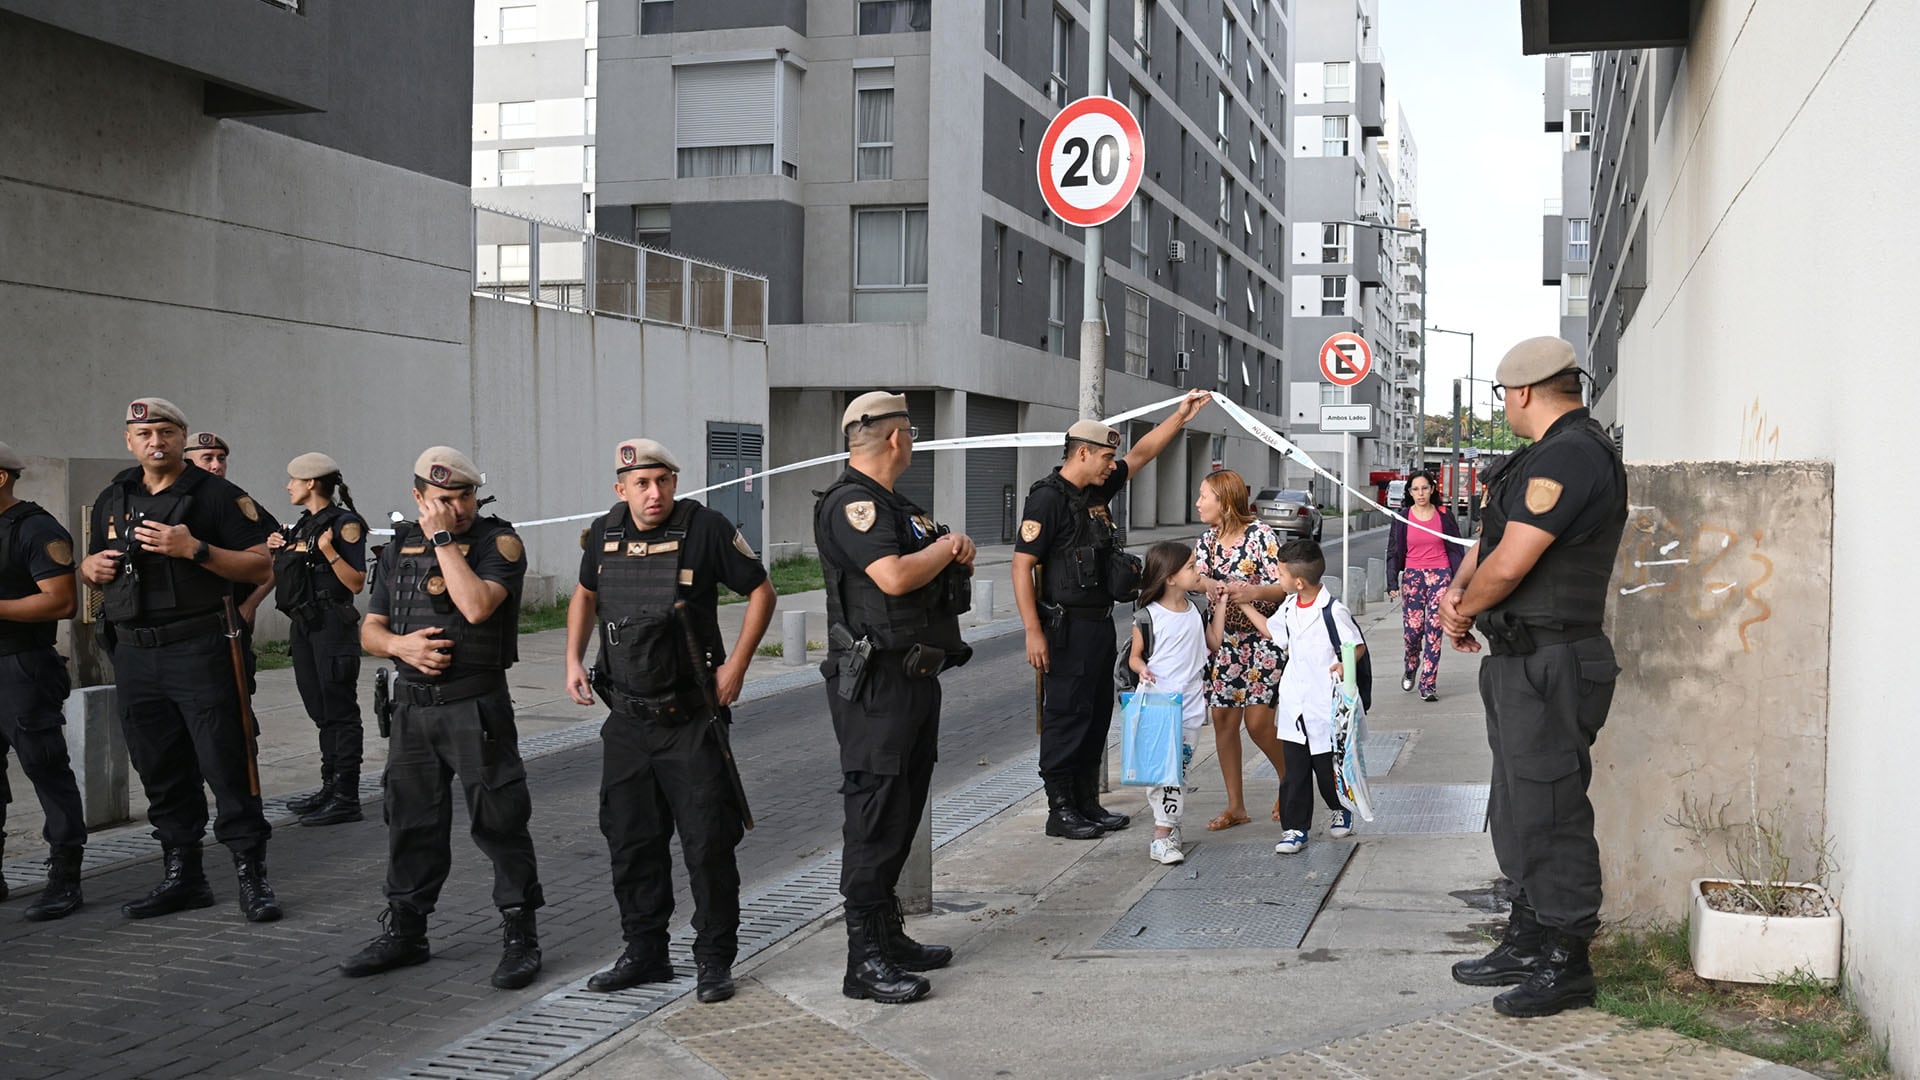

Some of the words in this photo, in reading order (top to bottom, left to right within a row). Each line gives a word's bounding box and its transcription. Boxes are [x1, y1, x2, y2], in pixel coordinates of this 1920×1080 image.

[1060, 134, 1120, 188] 20
[1335, 343, 1357, 374] E
[1252, 425, 1262, 435] NO
[1259, 431, 1278, 446] PASAR
[1162, 786, 1182, 814] STI
